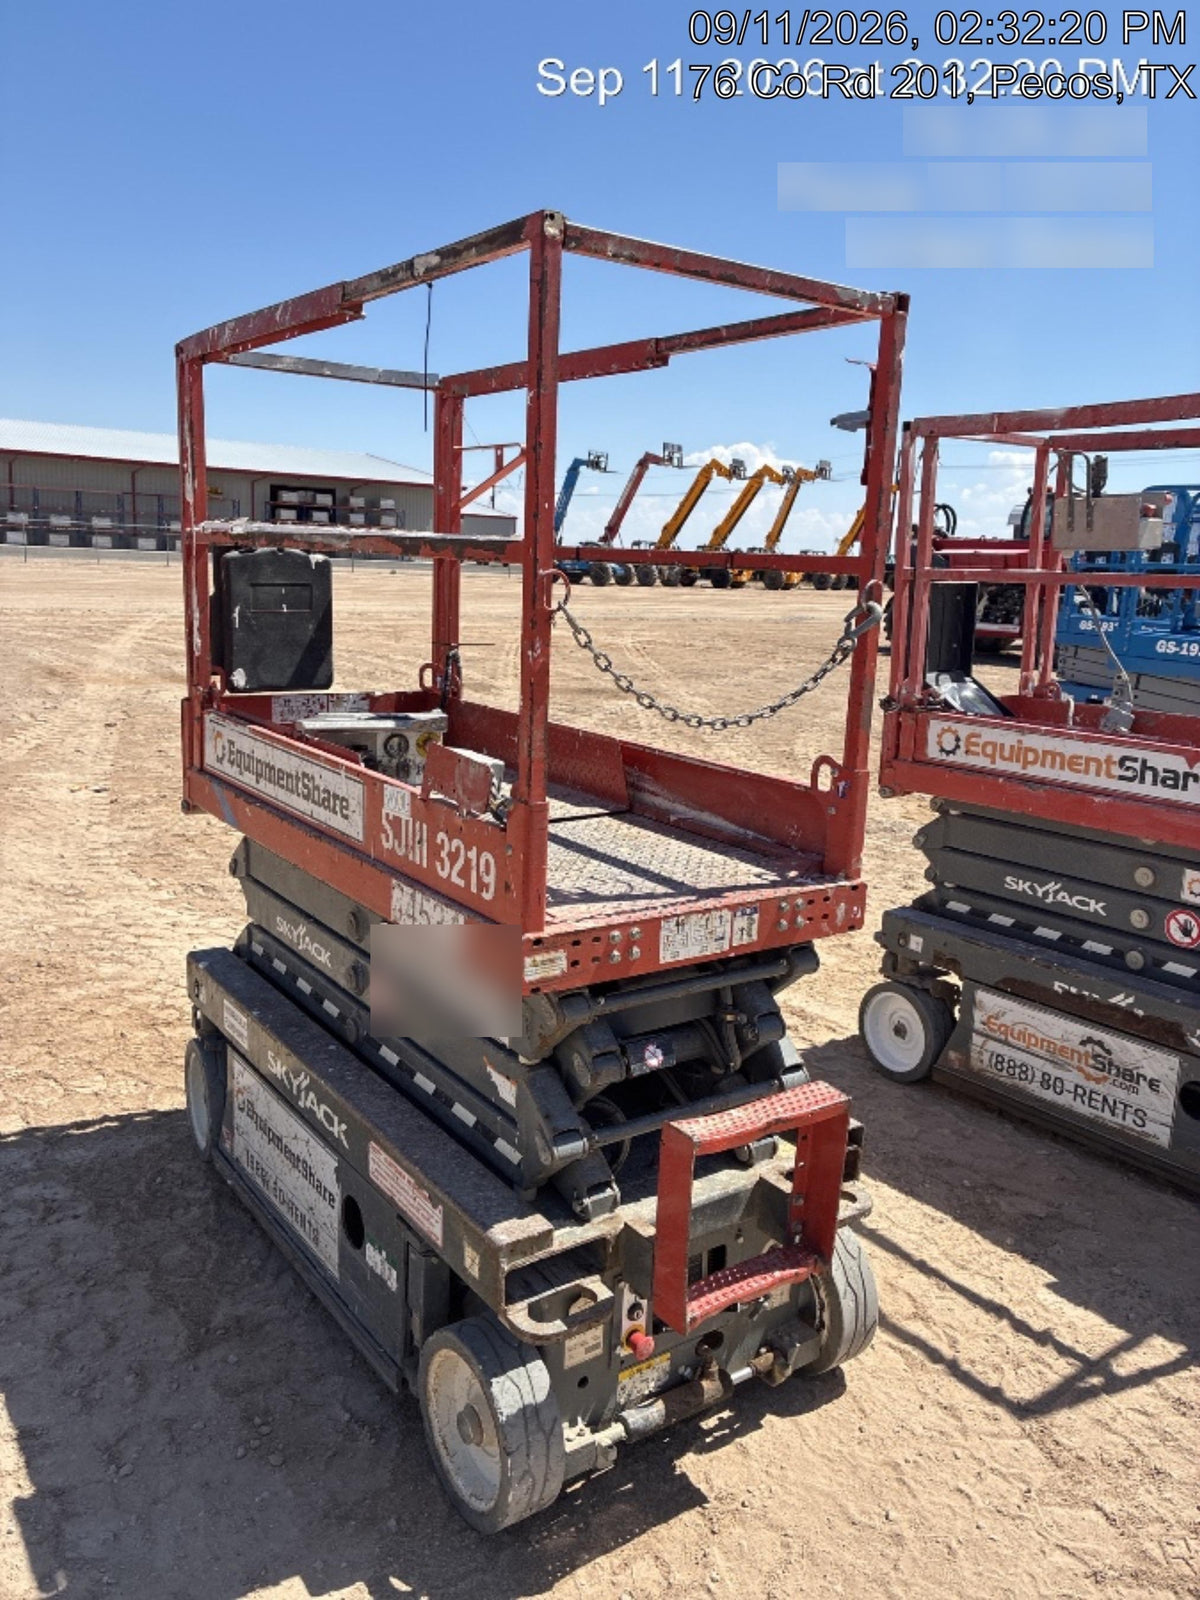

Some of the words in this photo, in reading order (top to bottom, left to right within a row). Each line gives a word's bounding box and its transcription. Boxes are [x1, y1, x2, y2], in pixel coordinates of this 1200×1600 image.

[1155, 639, 1200, 657] GS-19
[225, 738, 350, 821] EquipmentShare
[435, 831, 496, 901] 3219
[1004, 875, 1108, 916] SKYJACK
[275, 916, 332, 968] SKYJACK
[985, 1013, 1162, 1094] EquipmentShare
[988, 1051, 1036, 1086] (888)
[1040, 1071, 1148, 1128] 80-RENTS
[267, 1050, 349, 1149] SKYJACK
